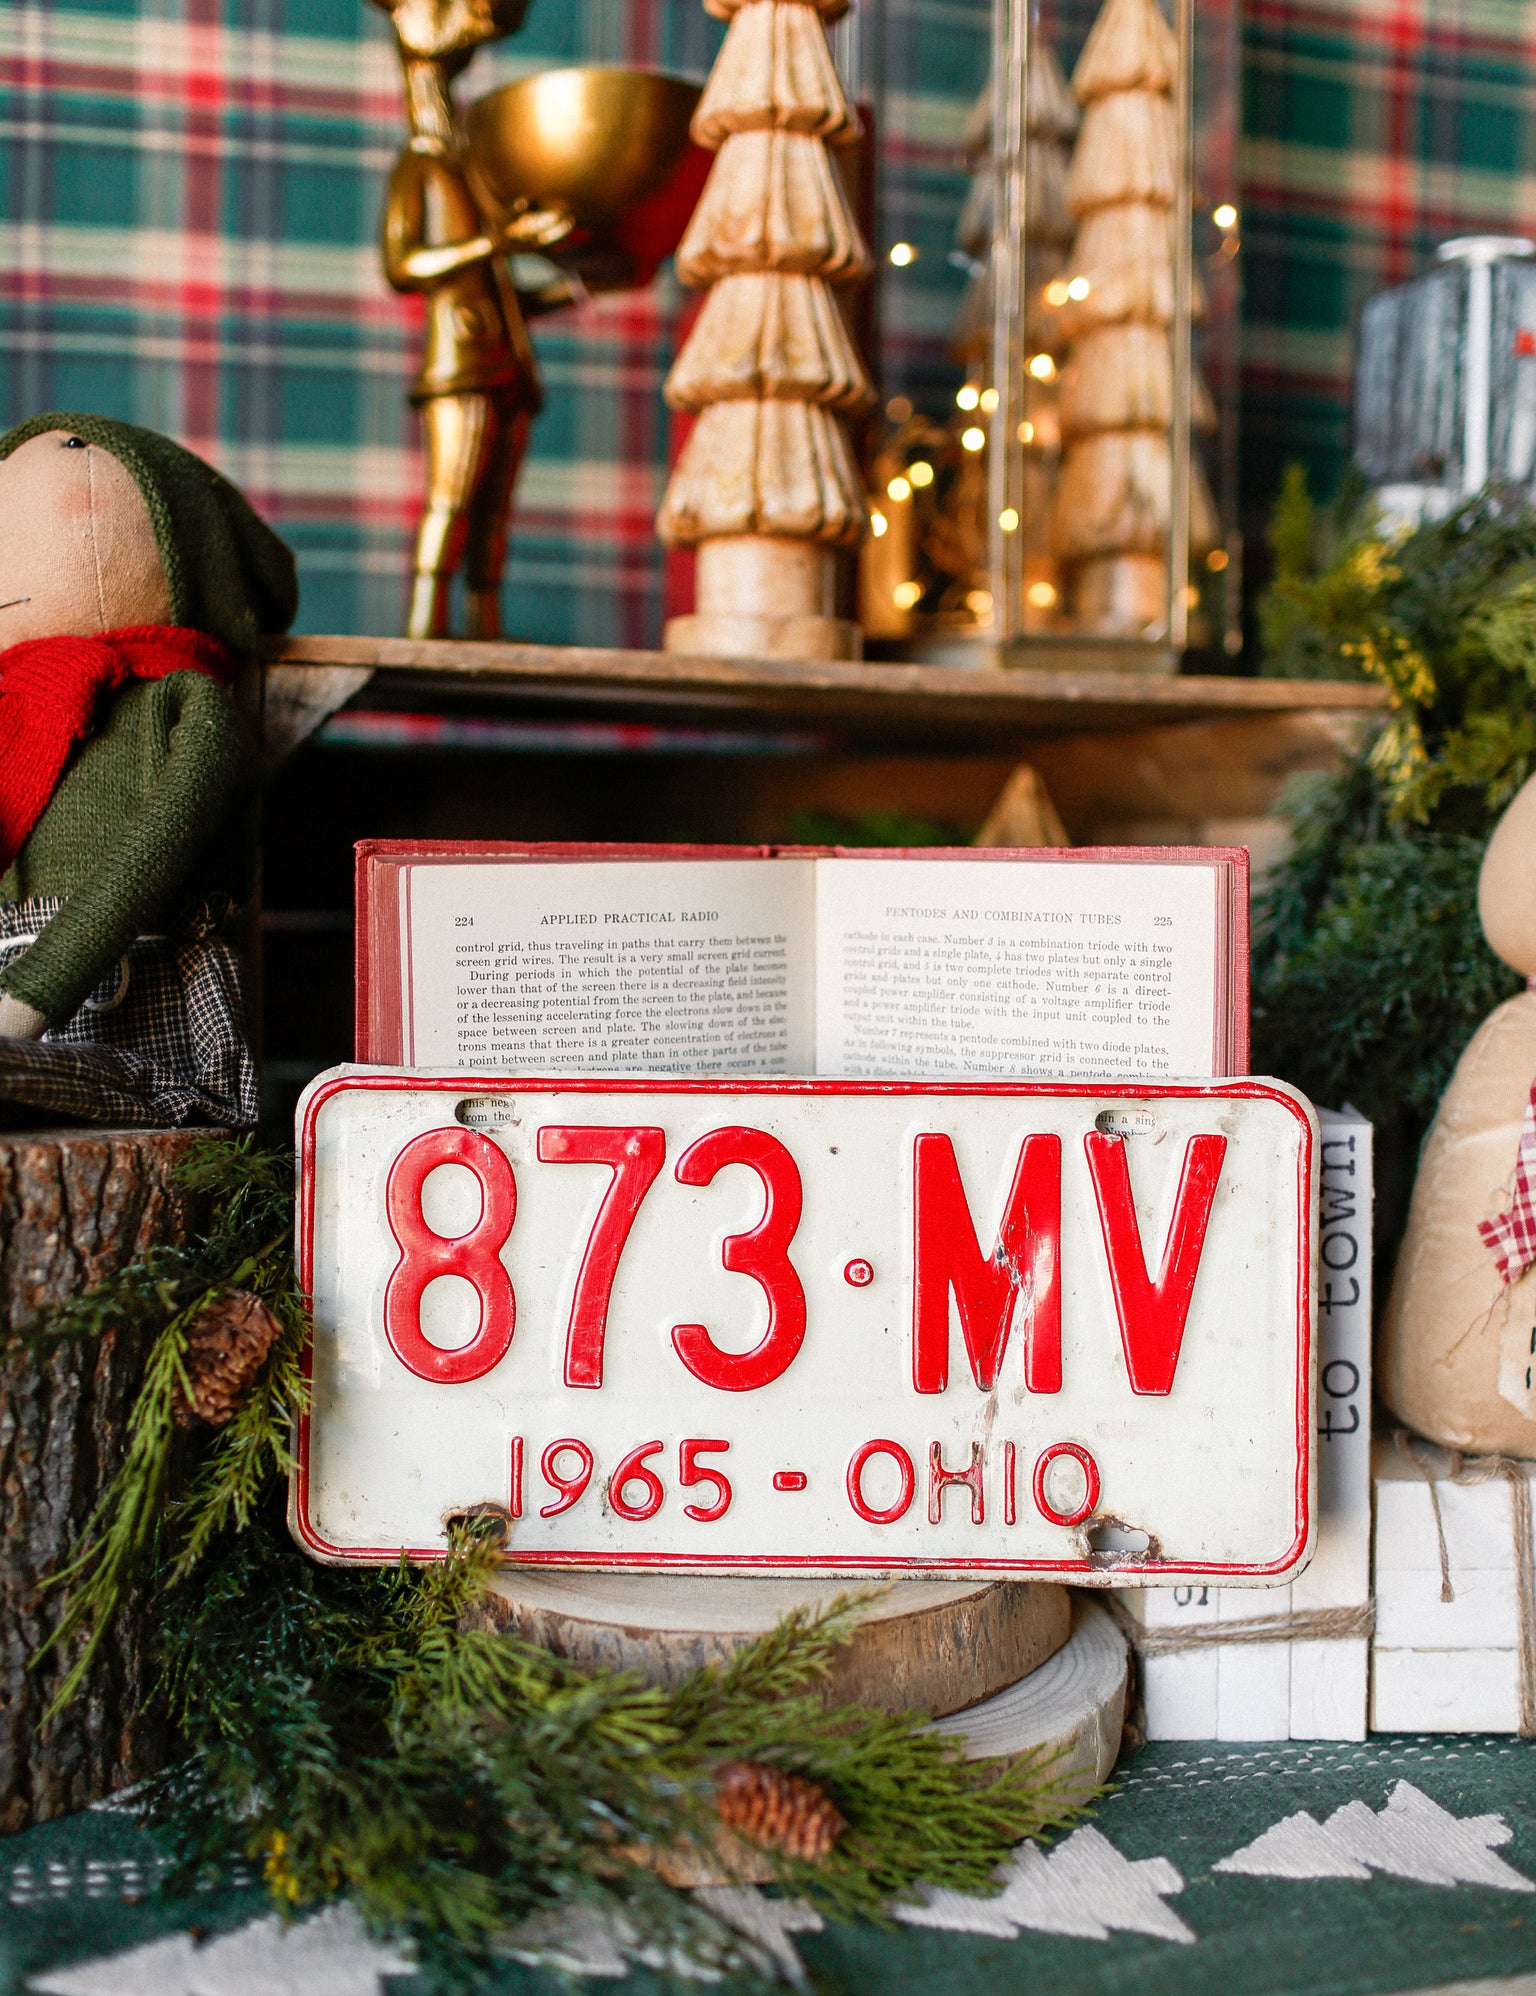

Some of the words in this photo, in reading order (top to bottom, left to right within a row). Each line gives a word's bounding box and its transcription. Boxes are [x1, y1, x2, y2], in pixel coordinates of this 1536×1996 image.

[455, 917, 474, 927] 224
[540, 914, 598, 925] APPLIED
[604, 912, 676, 924] PRACTICAL
[681, 911, 719, 922] RADIO
[885, 907, 947, 919] PENTODES
[953, 909, 979, 920] AND
[984, 911, 1073, 923] COMBINATION
[1080, 913, 1122, 925] TUBES
[1153, 916, 1173, 927] 225
[455, 942, 494, 952] control
[497, 941, 524, 954] grid,
[528, 941, 550, 951] thus
[555, 940, 603, 952] traveling
[607, 939, 617, 949] in
[621, 938, 650, 951] paths
[653, 937, 674, 948] that
[677, 939, 704, 949] carry
[944, 934, 984, 945] Number
[997, 936, 1005, 946] is
[1019, 938, 1083, 949] combination
[1088, 940, 1119, 950] triode
[1124, 941, 1147, 951] with
[1152, 944, 1172, 952] two
[494, 955, 517, 968] grid
[521, 955, 554, 965] wires.
[558, 954, 579, 964] The
[583, 952, 613, 963] result
[617, 952, 626, 962] is
[640, 954, 662, 964] very
[666, 950, 693, 961] small
[932, 948, 961, 961] single
[964, 949, 992, 961] plate,
[1004, 951, 1022, 961] has
[1025, 953, 1044, 962] two
[1048, 953, 1078, 965] plates
[1082, 954, 1099, 964] but
[1103, 955, 1125, 968] only
[1139, 957, 1171, 970] single
[470, 970, 508, 982] During
[515, 969, 555, 982] periods
[561, 969, 571, 978] in
[578, 967, 609, 978] which
[615, 966, 632, 977] the
[638, 964, 683, 978] potential
[688, 964, 699, 974] of
[945, 964, 963, 973] two
[966, 964, 1011, 977] complete
[1015, 966, 1051, 977] triodes
[1056, 968, 1079, 978] with
[1083, 972, 1128, 982] separate
[1133, 972, 1171, 982] control
[457, 985, 487, 995] lower
[491, 984, 515, 994] than
[520, 983, 541, 993] that
[545, 983, 556, 993] of
[561, 982, 577, 992] the
[581, 984, 615, 992] screen
[619, 980, 646, 990] there
[650, 980, 659, 989] is
[672, 977, 724, 989] decreasing
[946, 976, 967, 989] only
[973, 980, 991, 988] one
[996, 979, 1039, 990] cathode.
[1046, 981, 1088, 992] Number
[1107, 984, 1116, 994] is
[1135, 985, 1171, 996] direct-
[480, 998, 538, 1010] decreasing
[542, 996, 589, 1010] potential
[593, 996, 619, 1006] from
[622, 994, 638, 1005] the
[641, 996, 674, 1004] screen
[677, 994, 687, 1002] to
[689, 992, 705, 1002] the
[959, 991, 1010, 1005] consisting
[1015, 993, 1025, 1003] of
[1042, 995, 1079, 1008] voltage
[1084, 998, 1132, 1010] amplifier
[1138, 1000, 1170, 1011] triode
[457, 1013, 467, 1023] of
[472, 1012, 489, 1023] the
[493, 1012, 542, 1024] lessening
[546, 1010, 611, 1022] accelerating
[615, 1009, 642, 1019] force
[645, 1007, 661, 1017] the
[664, 1006, 709, 1016] electrons
[950, 1004, 979, 1015] triode
[984, 1006, 1007, 1016] with
[1011, 1007, 1028, 1018] the
[1032, 1008, 1059, 1022] input
[1065, 1011, 1086, 1021] unit
[1091, 1013, 1131, 1025] coupled
[1137, 1016, 1147, 1024] to
[1153, 1015, 1169, 1025] the
[950, 1018, 974, 1029] tube.
[457, 1030, 487, 1039] space
[492, 1026, 536, 1036] between
[542, 1027, 576, 1035] screen
[581, 1023, 601, 1034] and
[606, 1022, 636, 1035] plate.
[642, 1021, 660, 1031] The
[665, 1020, 703, 1031] slowing
[458, 1042, 486, 1051] trons
[529, 1039, 550, 1049] that
[556, 1038, 584, 1049] there
[588, 1038, 597, 1048] is
[611, 1037, 649, 1049] greater
[653, 1032, 720, 1045] concentration
[959, 1033, 998, 1044] pentode
[1000, 1036, 1049, 1047] combined
[1053, 1039, 1076, 1049] with
[1079, 1041, 1099, 1050] two
[1102, 1041, 1130, 1052] diode
[1134, 1043, 1169, 1055] plates.
[469, 1055, 496, 1068] point
[501, 1054, 545, 1064] between
[588, 1051, 607, 1062] and
[611, 1051, 637, 1063] plate
[641, 1049, 664, 1059] than
[668, 1048, 678, 1058] in
[682, 1046, 707, 1057] other
[648, 1060, 690, 1072] negative
[960, 1046, 976, 1056] the
[979, 1050, 1035, 1061] suppressor
[1039, 1052, 1061, 1063] grid
[1066, 1053, 1075, 1063] is
[1079, 1056, 1131, 1066] connected
[1136, 1058, 1147, 1067] to
[1151, 1058, 1168, 1068] the
[963, 1060, 1004, 1072] Number
[1020, 1064, 1052, 1075] shows
[494, 1111, 511, 1121] the
[1319, 1135, 1360, 1315] town
[1318, 1359, 1361, 1442] to
[508, 1436, 734, 1523] 1965
[846, 1438, 1104, 1527] OHIO
